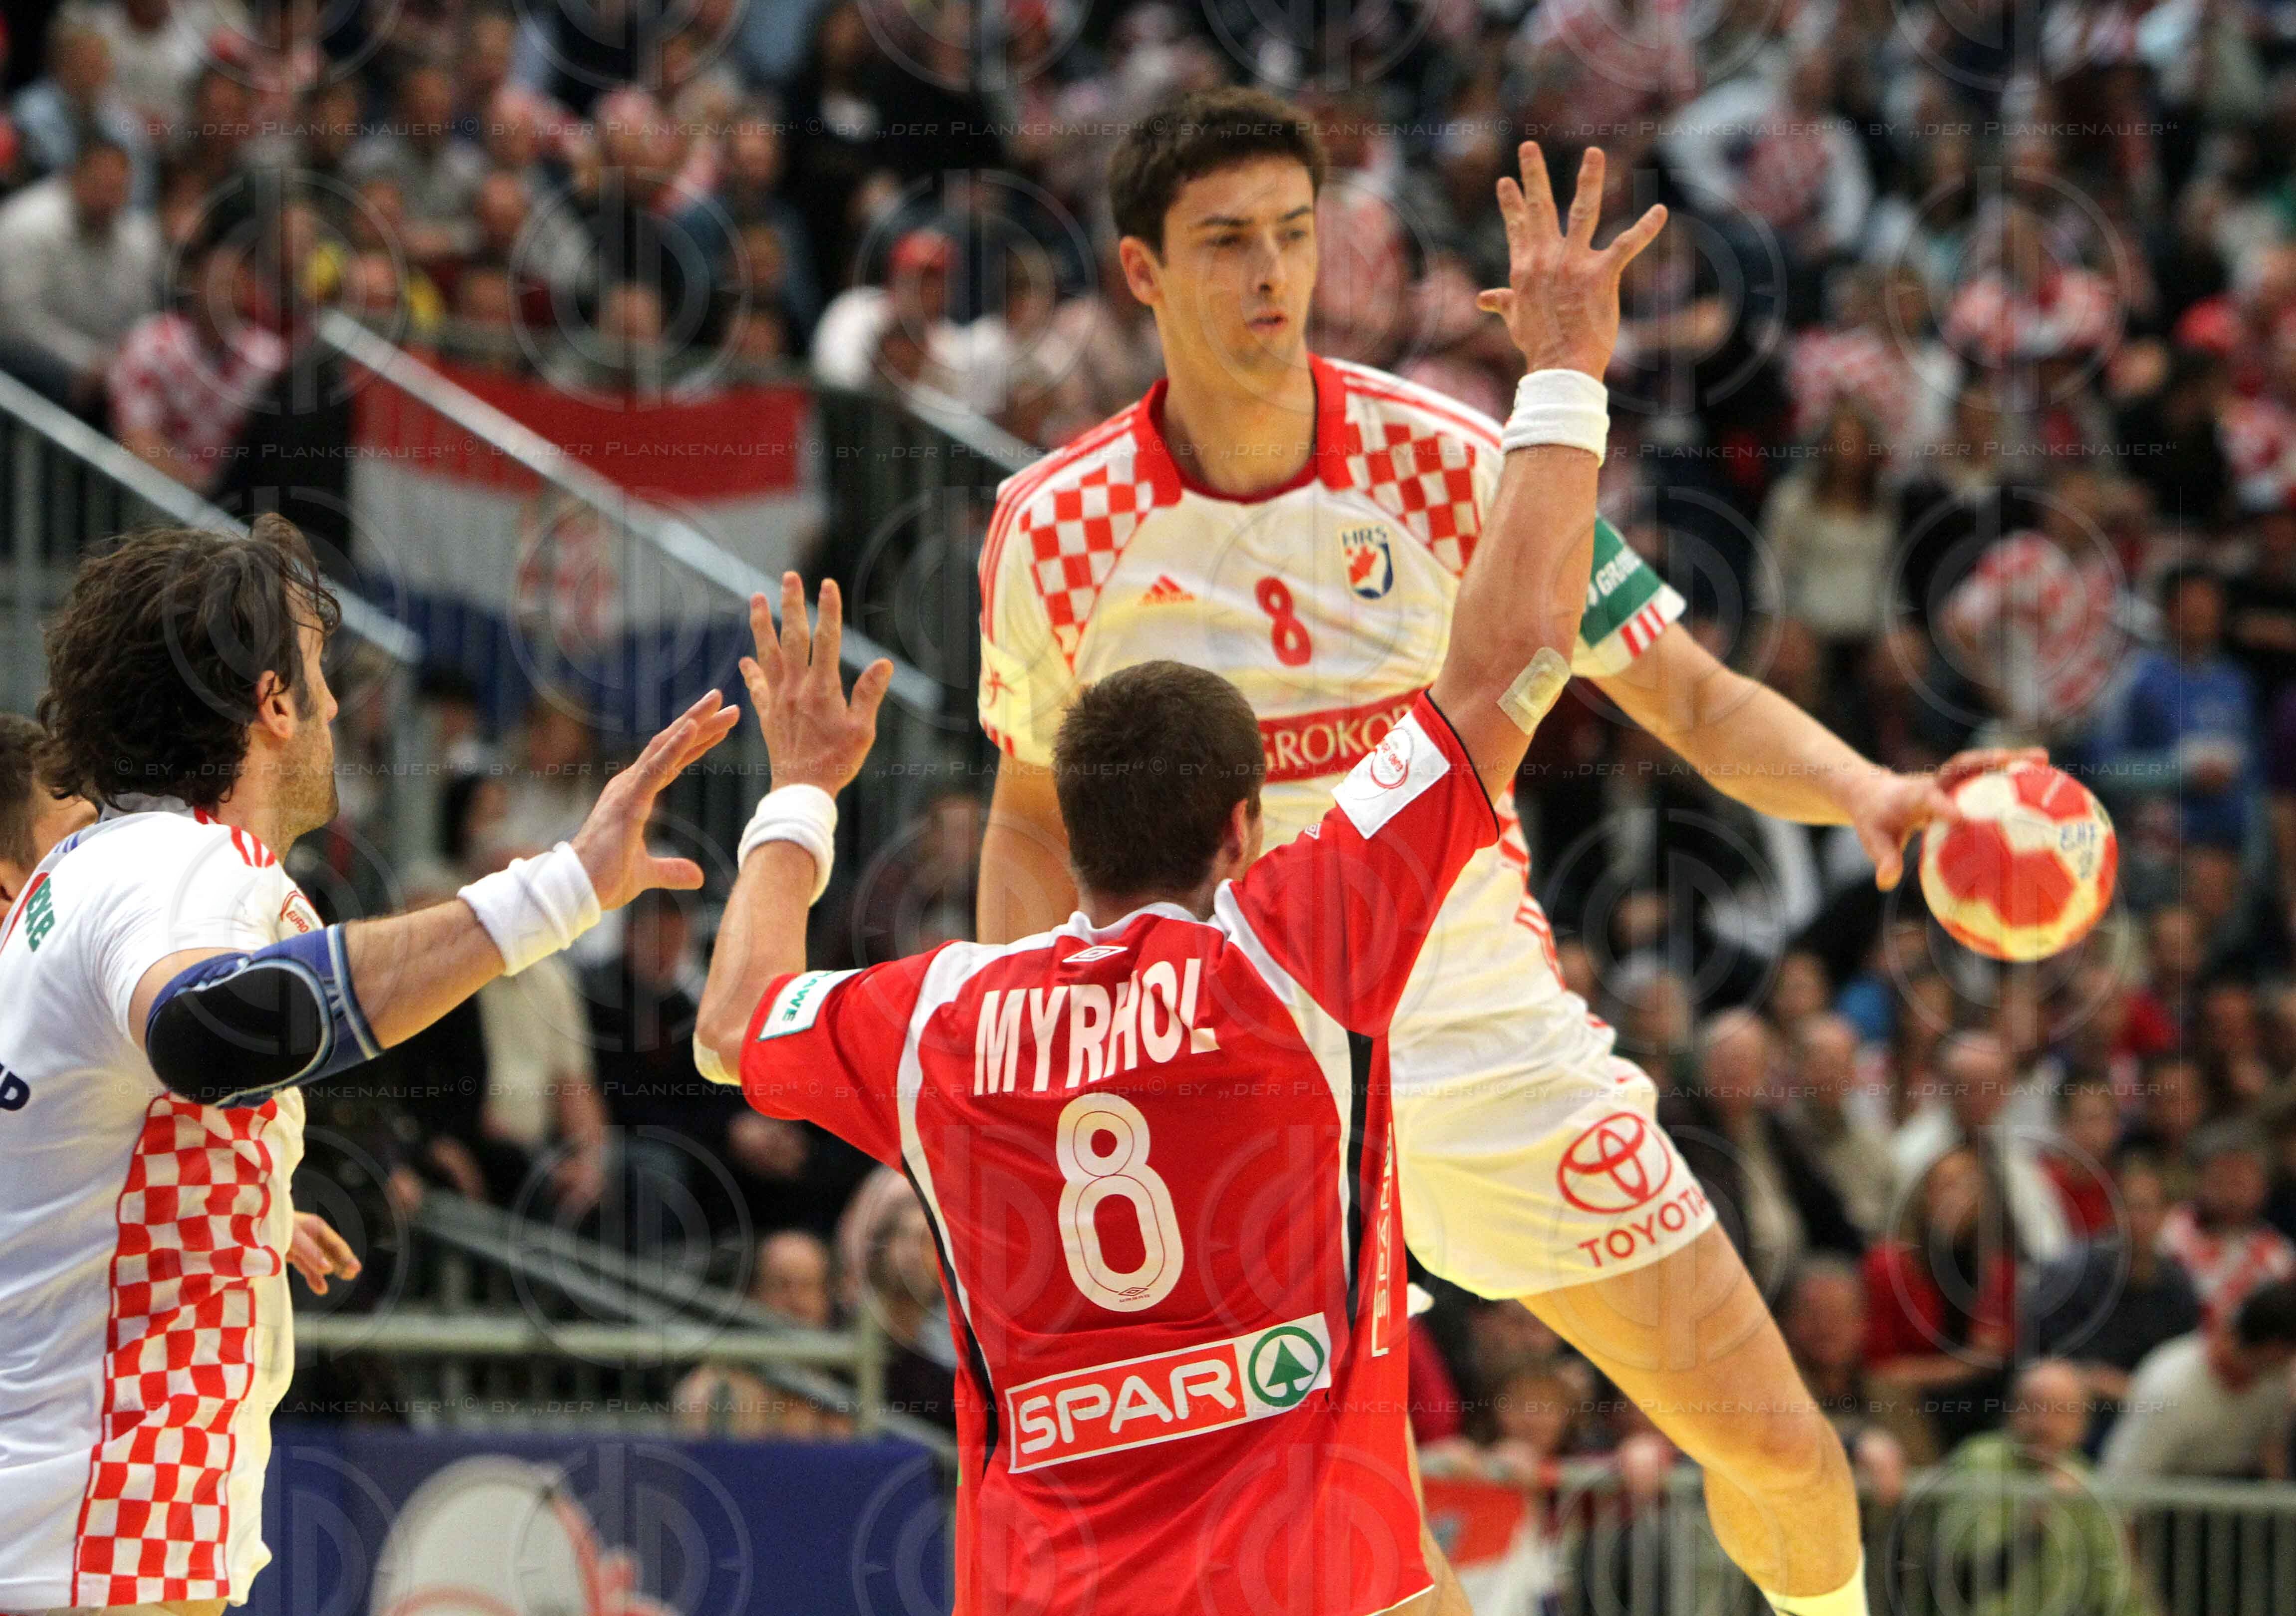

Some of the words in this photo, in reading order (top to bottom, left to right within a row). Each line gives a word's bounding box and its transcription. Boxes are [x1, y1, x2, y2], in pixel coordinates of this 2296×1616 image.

[1255, 576, 1313, 668] 8
[974, 958, 1221, 1096] MYRHOL
[1056, 1092, 1185, 1313] 8
[1577, 1184, 1708, 1268] TOYOTA
[1019, 1359, 1236, 1455] SPAR
